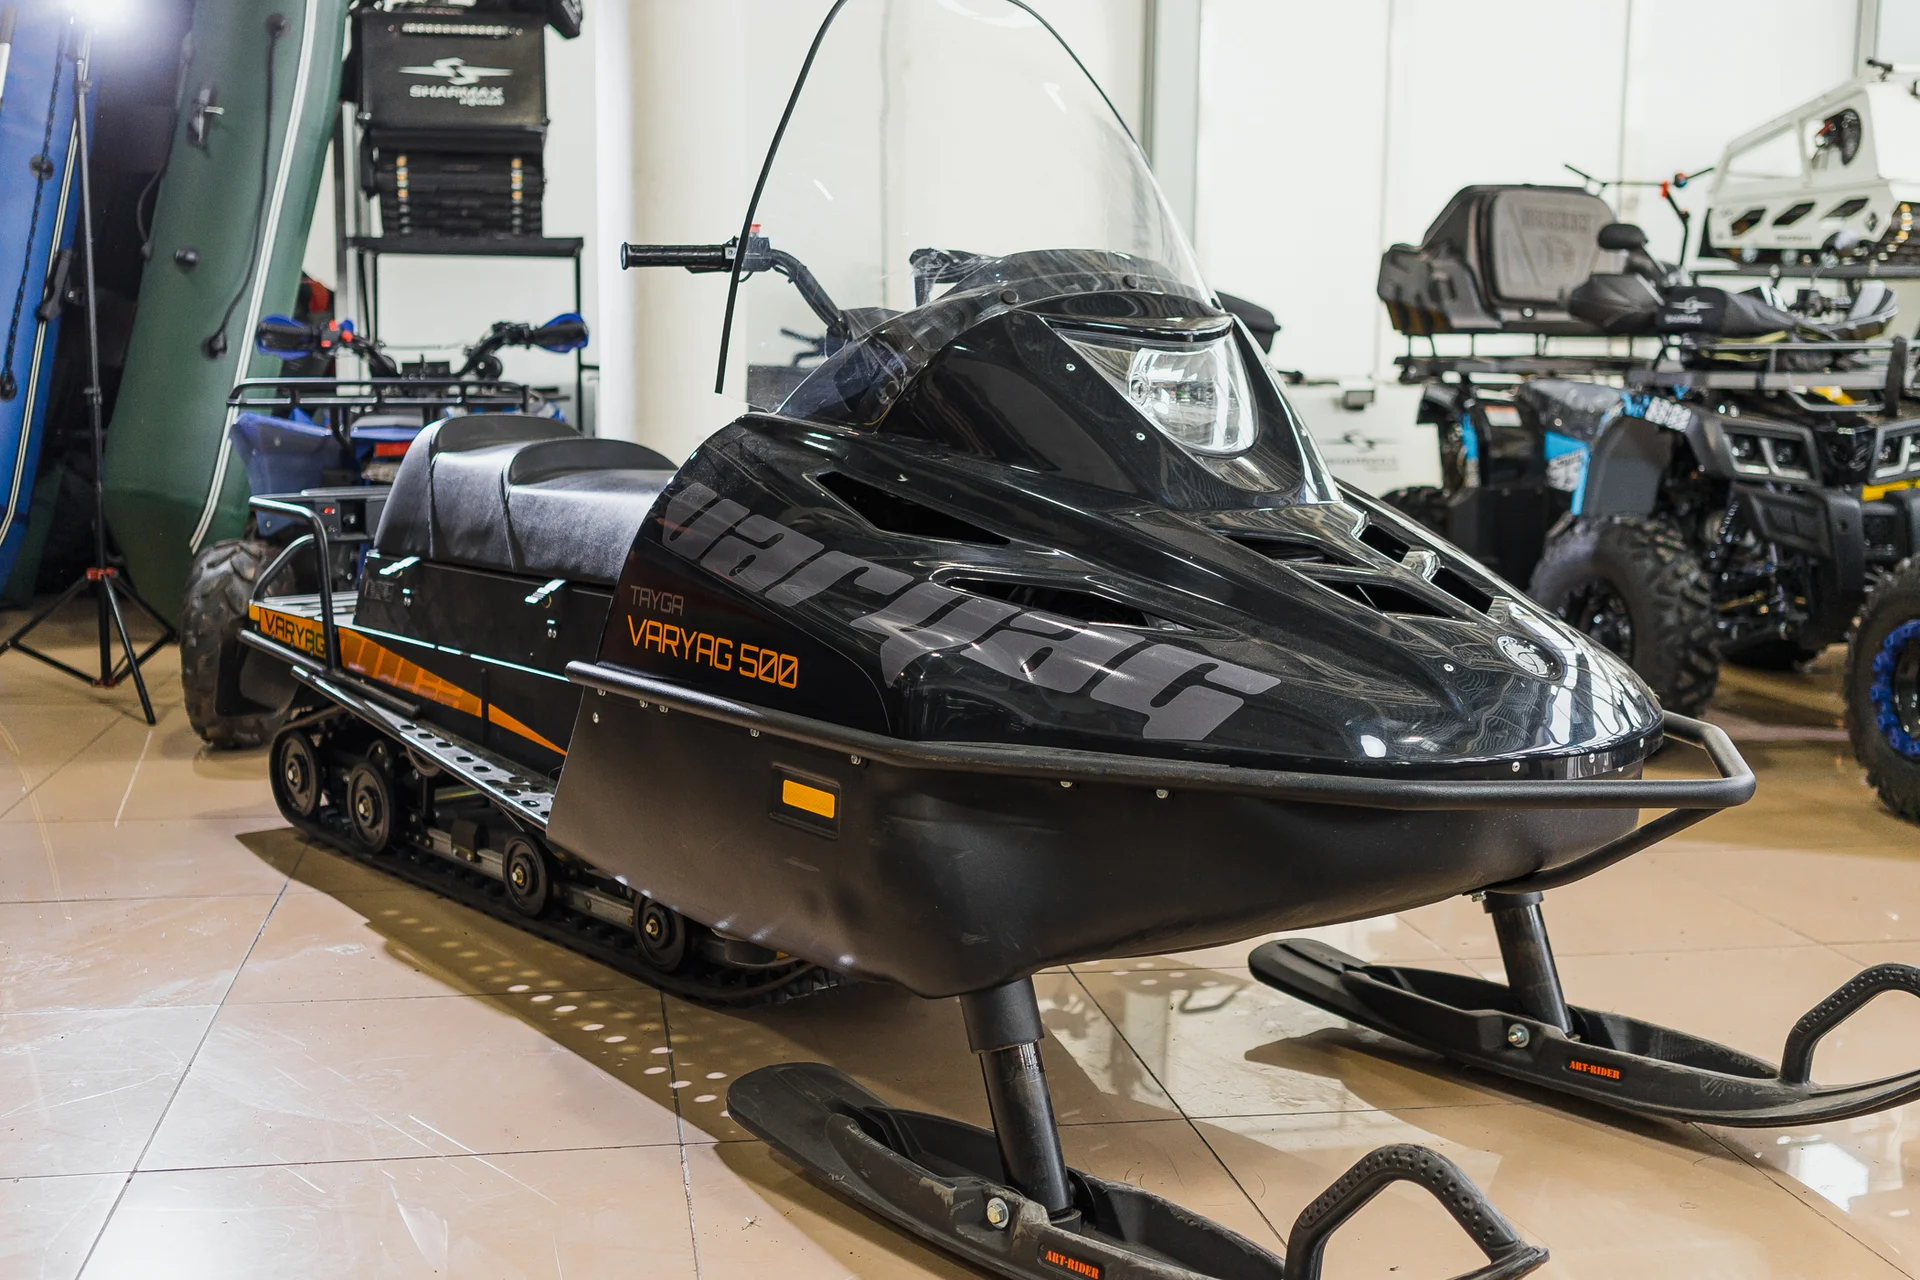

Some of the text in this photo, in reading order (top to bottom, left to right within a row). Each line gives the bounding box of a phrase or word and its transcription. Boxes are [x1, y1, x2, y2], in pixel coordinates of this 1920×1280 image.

[409, 84, 504, 99] SHARMAX
[629, 584, 685, 617] TAYGA
[264, 610, 326, 655] VARYAG
[627, 614, 799, 690] VARYAG 500
[1569, 1059, 1621, 1080] ART-RIDER
[1045, 1249, 1100, 1280] ART-RIDER
